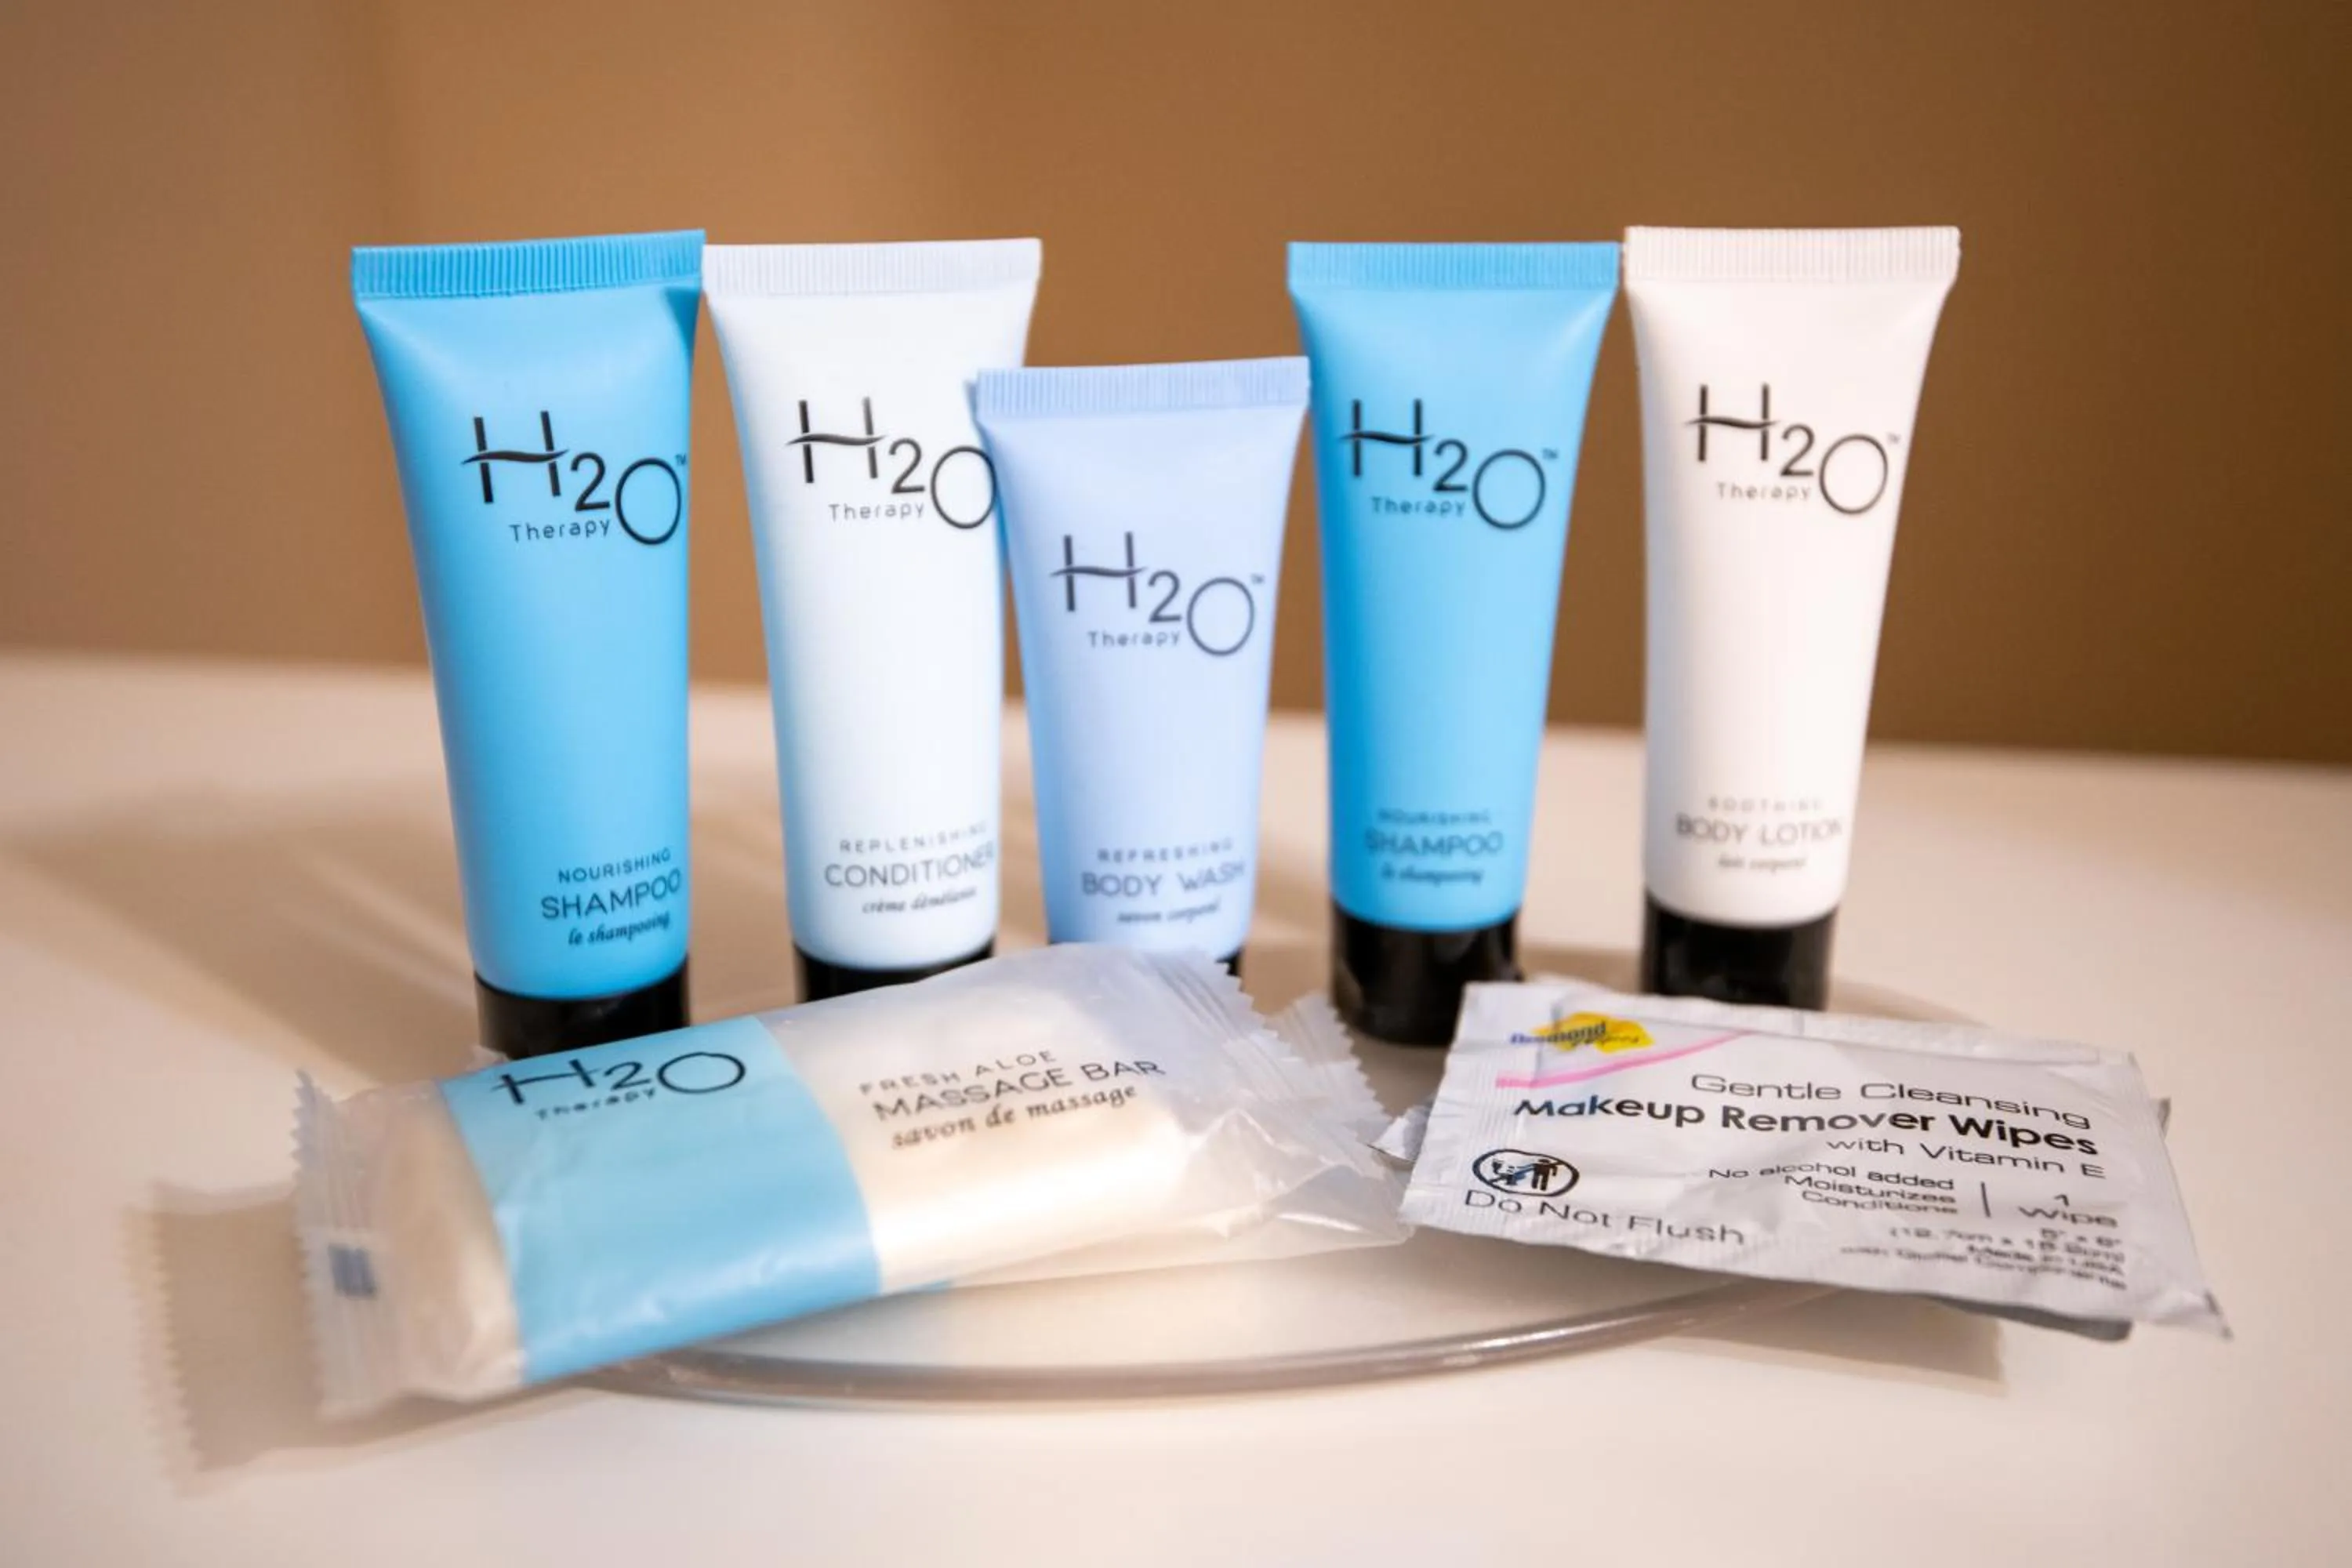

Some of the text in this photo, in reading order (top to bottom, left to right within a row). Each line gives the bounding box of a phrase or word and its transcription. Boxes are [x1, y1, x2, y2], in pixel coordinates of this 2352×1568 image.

[785, 396, 998, 529] H2O
[1338, 399, 1546, 530] H2O
[1684, 383, 1889, 515] H2O
[461, 410, 681, 546] H2O
[1716, 481, 1813, 502] Therapy
[829, 502, 925, 523] Therapy
[1370, 495, 1467, 517] Therapy
[509, 519, 612, 543] Therapy
[1050, 531, 1255, 657] H2O
[1087, 630, 1182, 648] Therapy
[840, 821, 988, 854] REPLENISHING
[1364, 827, 1504, 858] SHAMPOO
[1675, 812, 1748, 844] BODY
[558, 847, 672, 884] NOURISHING
[825, 840, 995, 888] CONDITIONER
[1081, 859, 1247, 898] BODY WASH
[541, 867, 681, 920] SHAMPOO
[568, 909, 671, 946] le shampooing
[492, 1051, 746, 1105] H2O
[859, 1049, 1058, 1097] FRESH ALOE
[872, 1060, 1167, 1122] MASSAGE BAR
[535, 1087, 657, 1121] Therapy
[891, 1085, 1139, 1150] savon de massage
[1691, 1073, 2092, 1131] Gentle Cleansing
[1513, 1094, 2100, 1156] Makeup Remover Wipes
[1708, 1162, 1955, 1191] No alcohol added
[1827, 1138, 2107, 1180] with Vitamin E
[1784, 1174, 1956, 1204] Moisturizes
[1802, 1189, 1958, 1215] Conditions
[2053, 1193, 2070, 1207] 1
[1464, 1189, 1746, 1247] Do Not Flush
